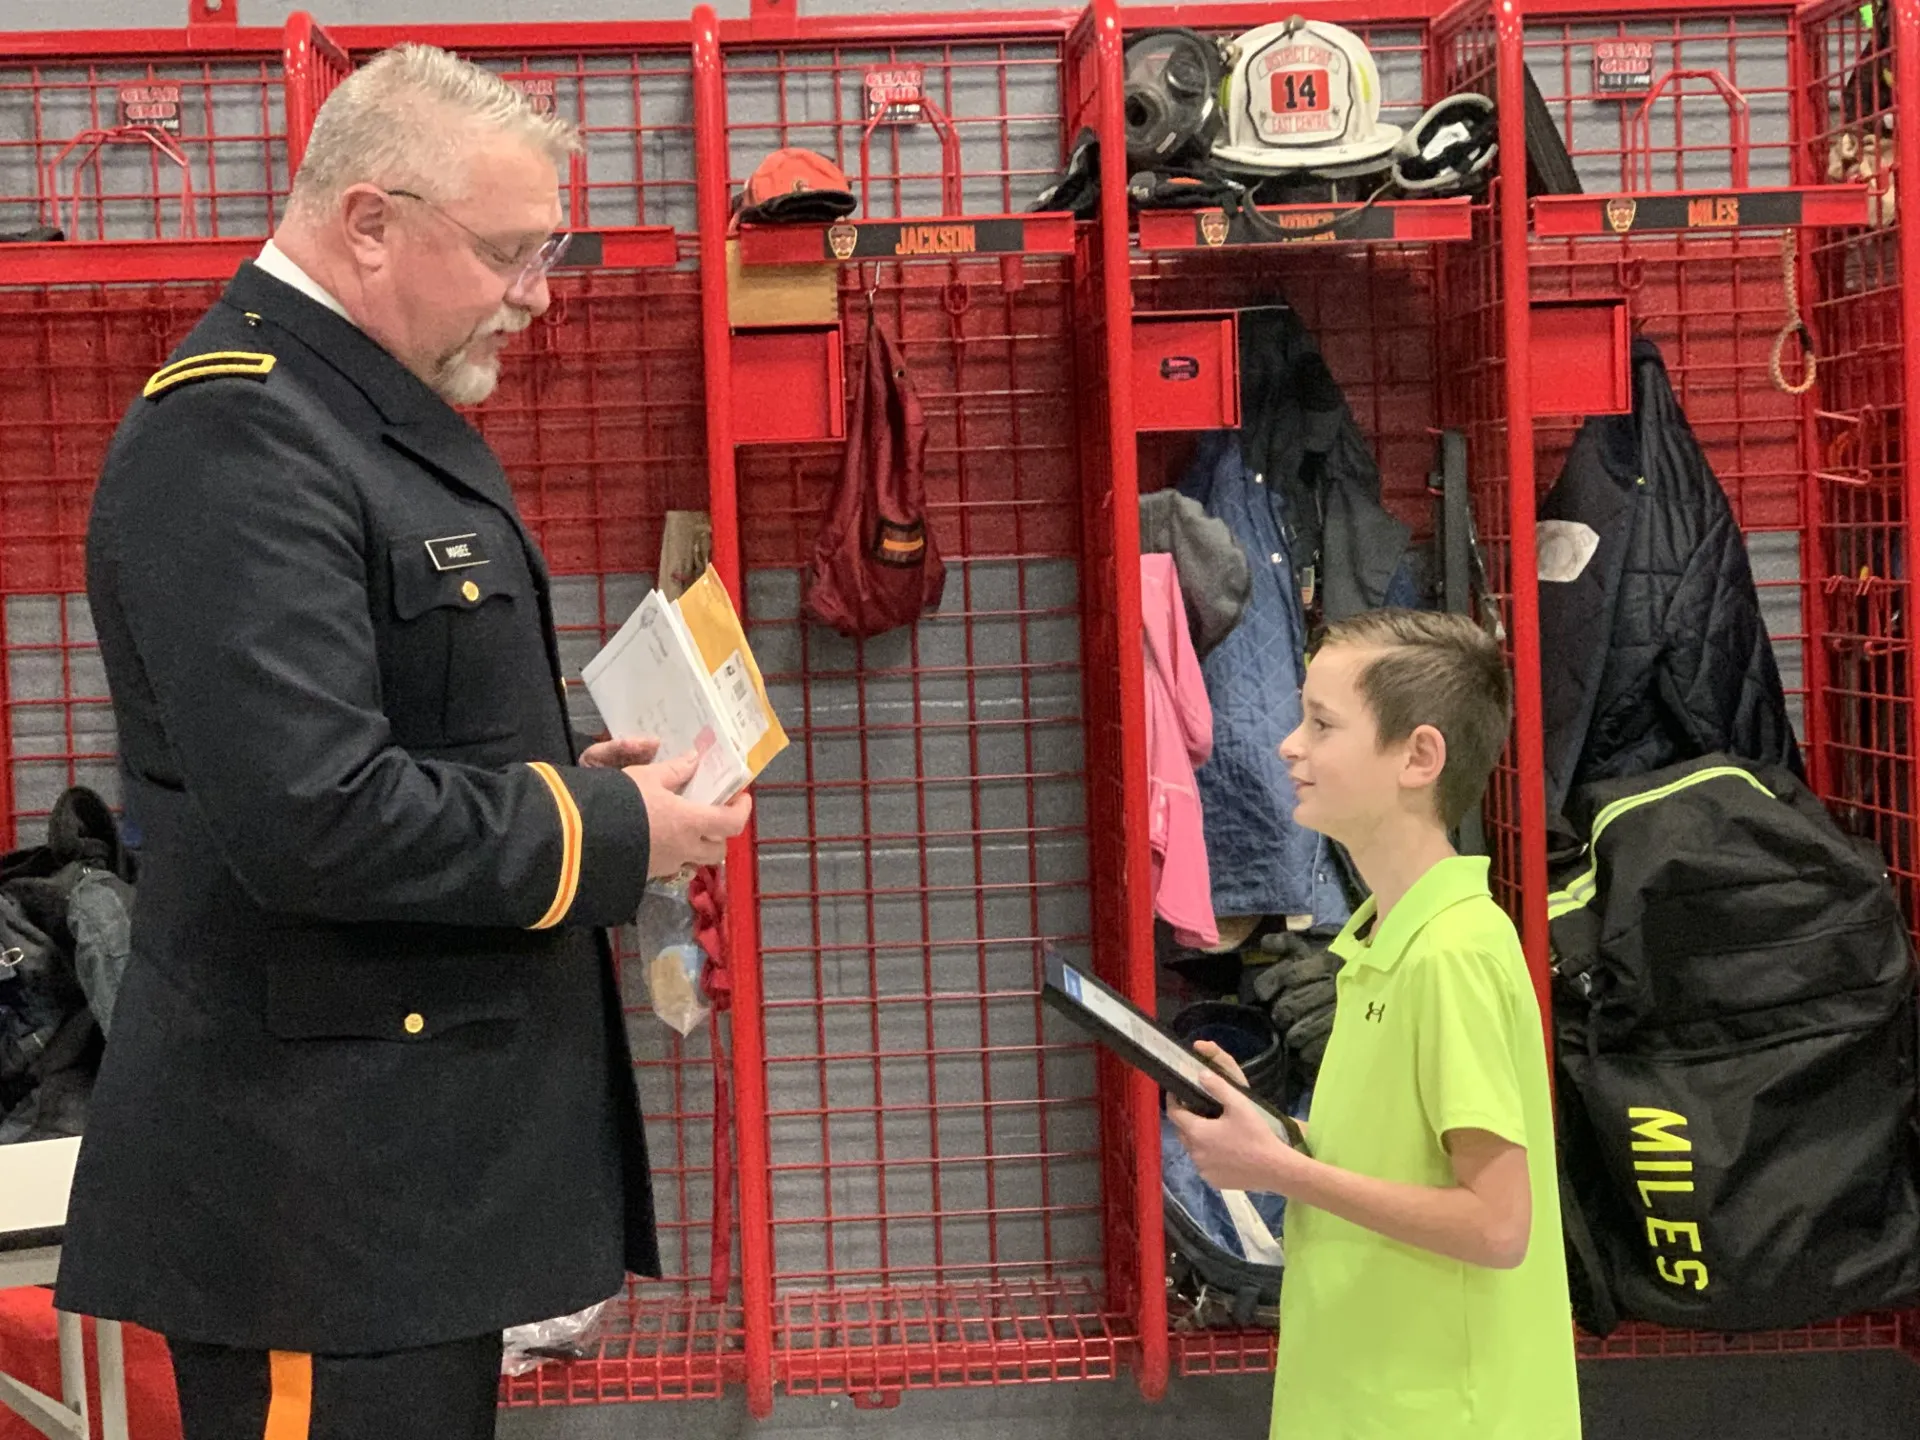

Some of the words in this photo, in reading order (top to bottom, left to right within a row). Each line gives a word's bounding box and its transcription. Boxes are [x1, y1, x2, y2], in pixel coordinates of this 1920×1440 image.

[1284, 74, 1316, 108] 14
[1688, 197, 1739, 227] MILES
[895, 225, 976, 255] JACKSON
[1628, 1107, 1708, 1290] MILES
